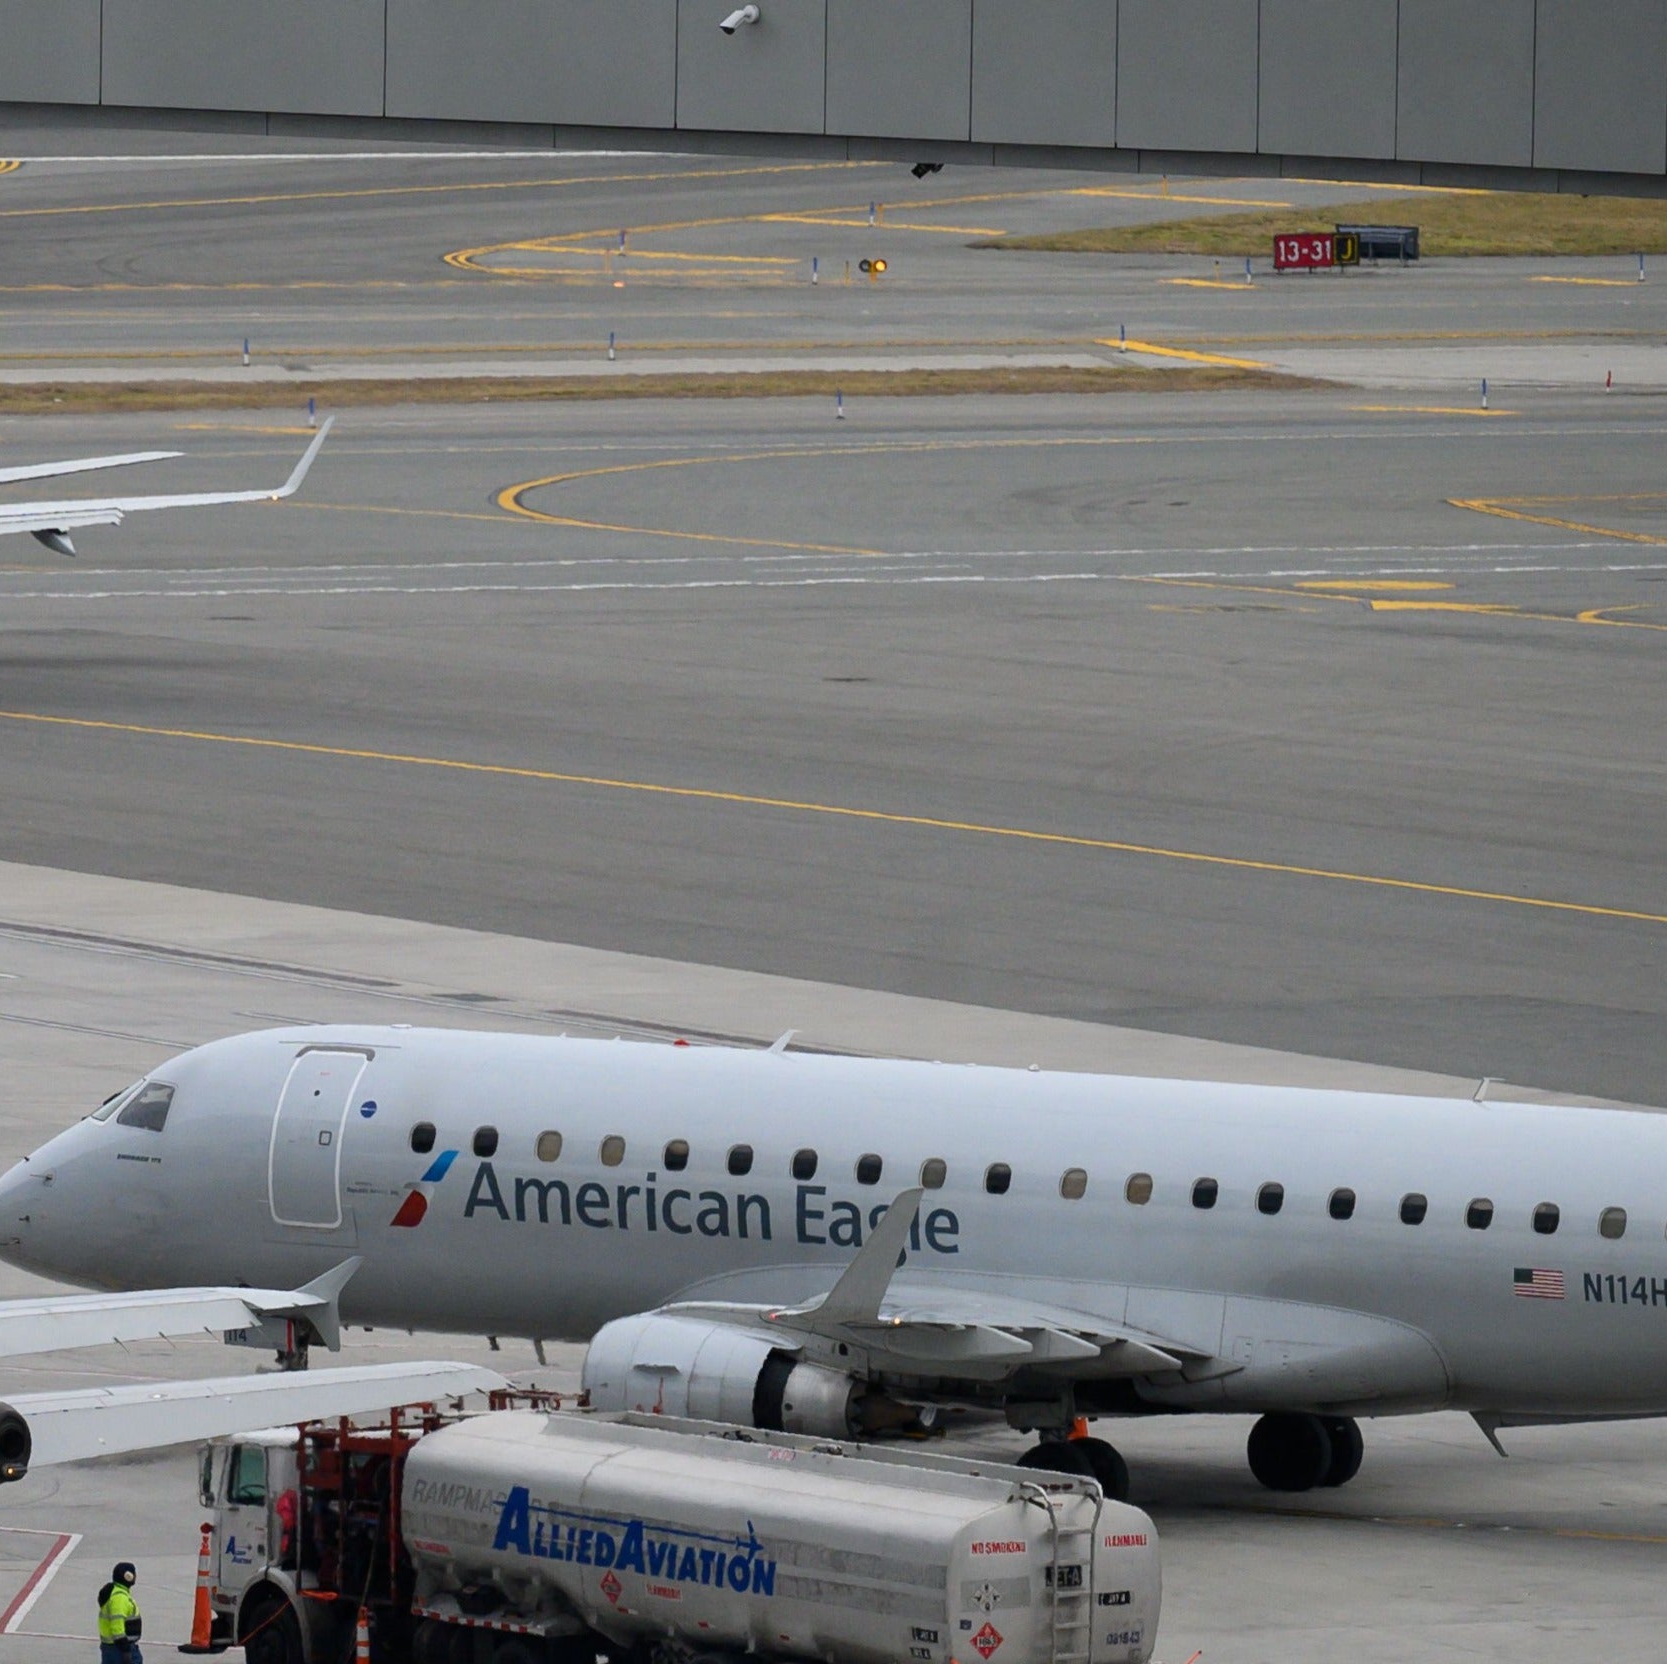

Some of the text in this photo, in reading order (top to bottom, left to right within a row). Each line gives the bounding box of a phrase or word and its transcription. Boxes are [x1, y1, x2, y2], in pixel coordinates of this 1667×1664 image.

[1279, 239, 1352, 262] 13-31 J
[463, 1160, 771, 1241] American
[971, 1541, 1026, 1555] NO SMOKING
[1104, 1534, 1148, 1548] FLAMMABLE
